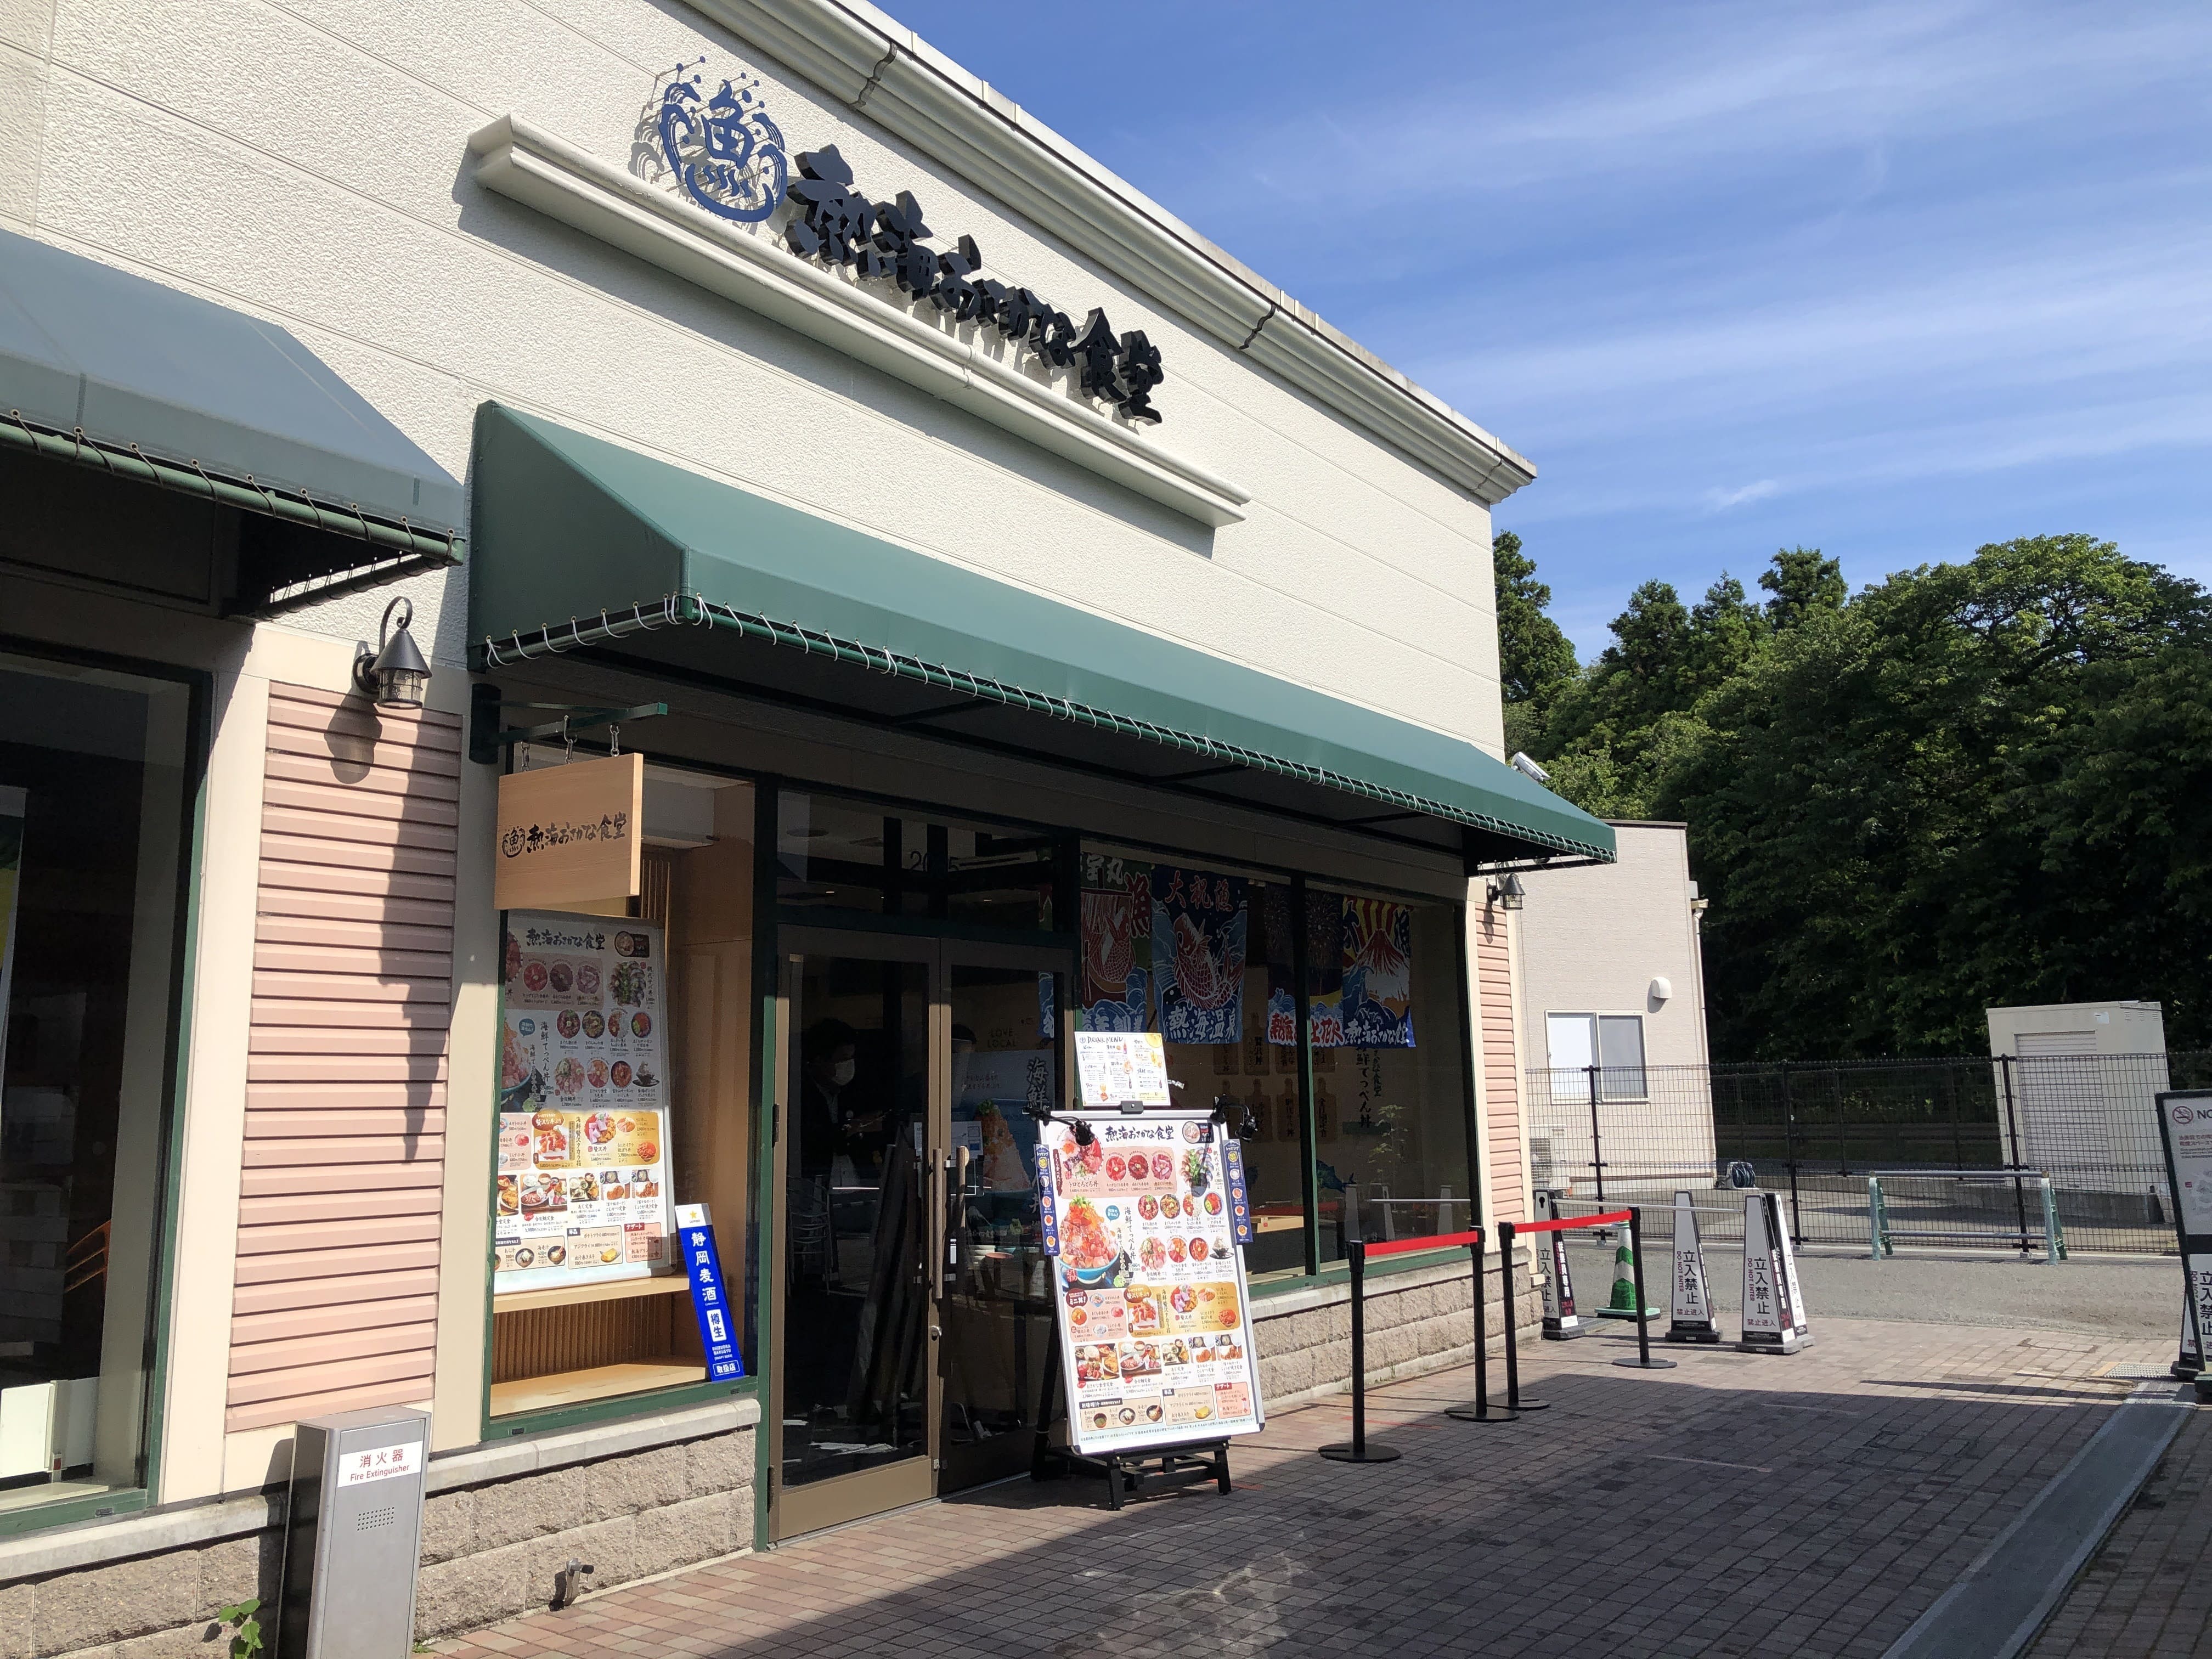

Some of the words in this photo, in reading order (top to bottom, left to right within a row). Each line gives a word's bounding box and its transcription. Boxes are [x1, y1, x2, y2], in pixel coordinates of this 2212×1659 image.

[786, 143, 1163, 426] 熱海おさかな食堂
[527, 811, 627, 854] 熱海おさかな食堂
[526, 928, 605, 950] 熱海おさかな食堂
[540, 1021, 550, 1081] 海鮮てっぺん丼
[1105, 1125, 1174, 1142] 熱海おさかな食堂
[1125, 1206, 1136, 1260] 海鮮てっぺん丼
[691, 1232, 716, 1302] 静岡麦酒
[1677, 1251, 1682, 1260] DO
[1747, 1257, 1753, 1267] DO
[1683, 1250, 1699, 1305] 立入禁止
[1754, 1257, 1770, 1314] 立入禁止
[710, 1312, 724, 1338] 樽生
[1747, 1318, 1776, 1327] 禁止进入
[716, 1361, 736, 1373] 取扱店
[360, 1448, 403, 1468] 消火器
[350, 1473, 364, 1482] Fire
[366, 1464, 410, 1479] Extinguisher
